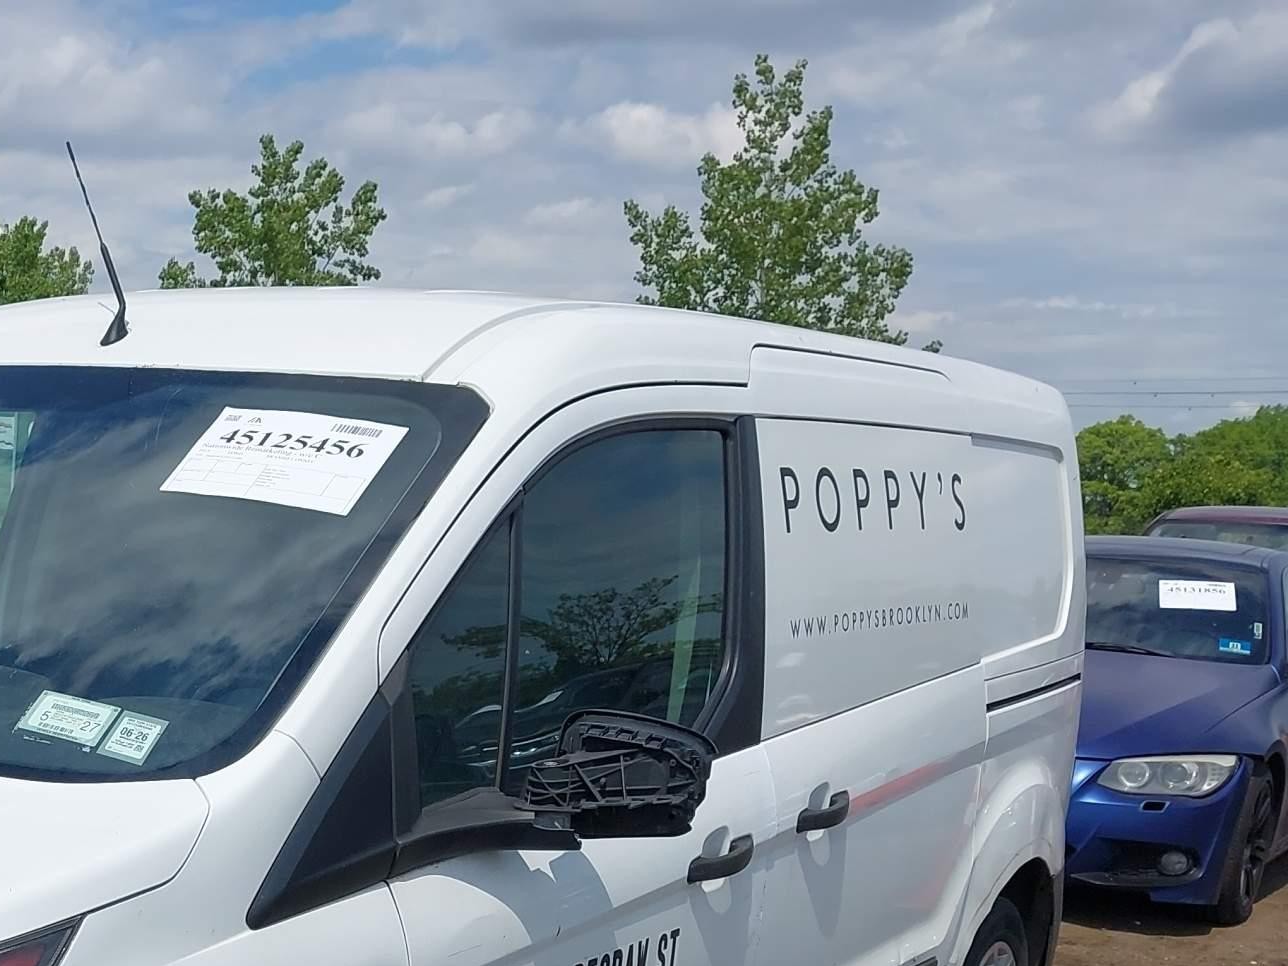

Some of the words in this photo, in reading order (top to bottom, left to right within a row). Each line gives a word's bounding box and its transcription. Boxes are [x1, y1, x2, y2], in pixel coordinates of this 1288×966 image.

[219, 428, 366, 458] 45125456
[779, 466, 966, 533] POPPY'S
[790, 602, 969, 638] WWW.POPPYSBROOKLYN.COM
[40, 710, 52, 721] 5
[79, 720, 101, 732] 27
